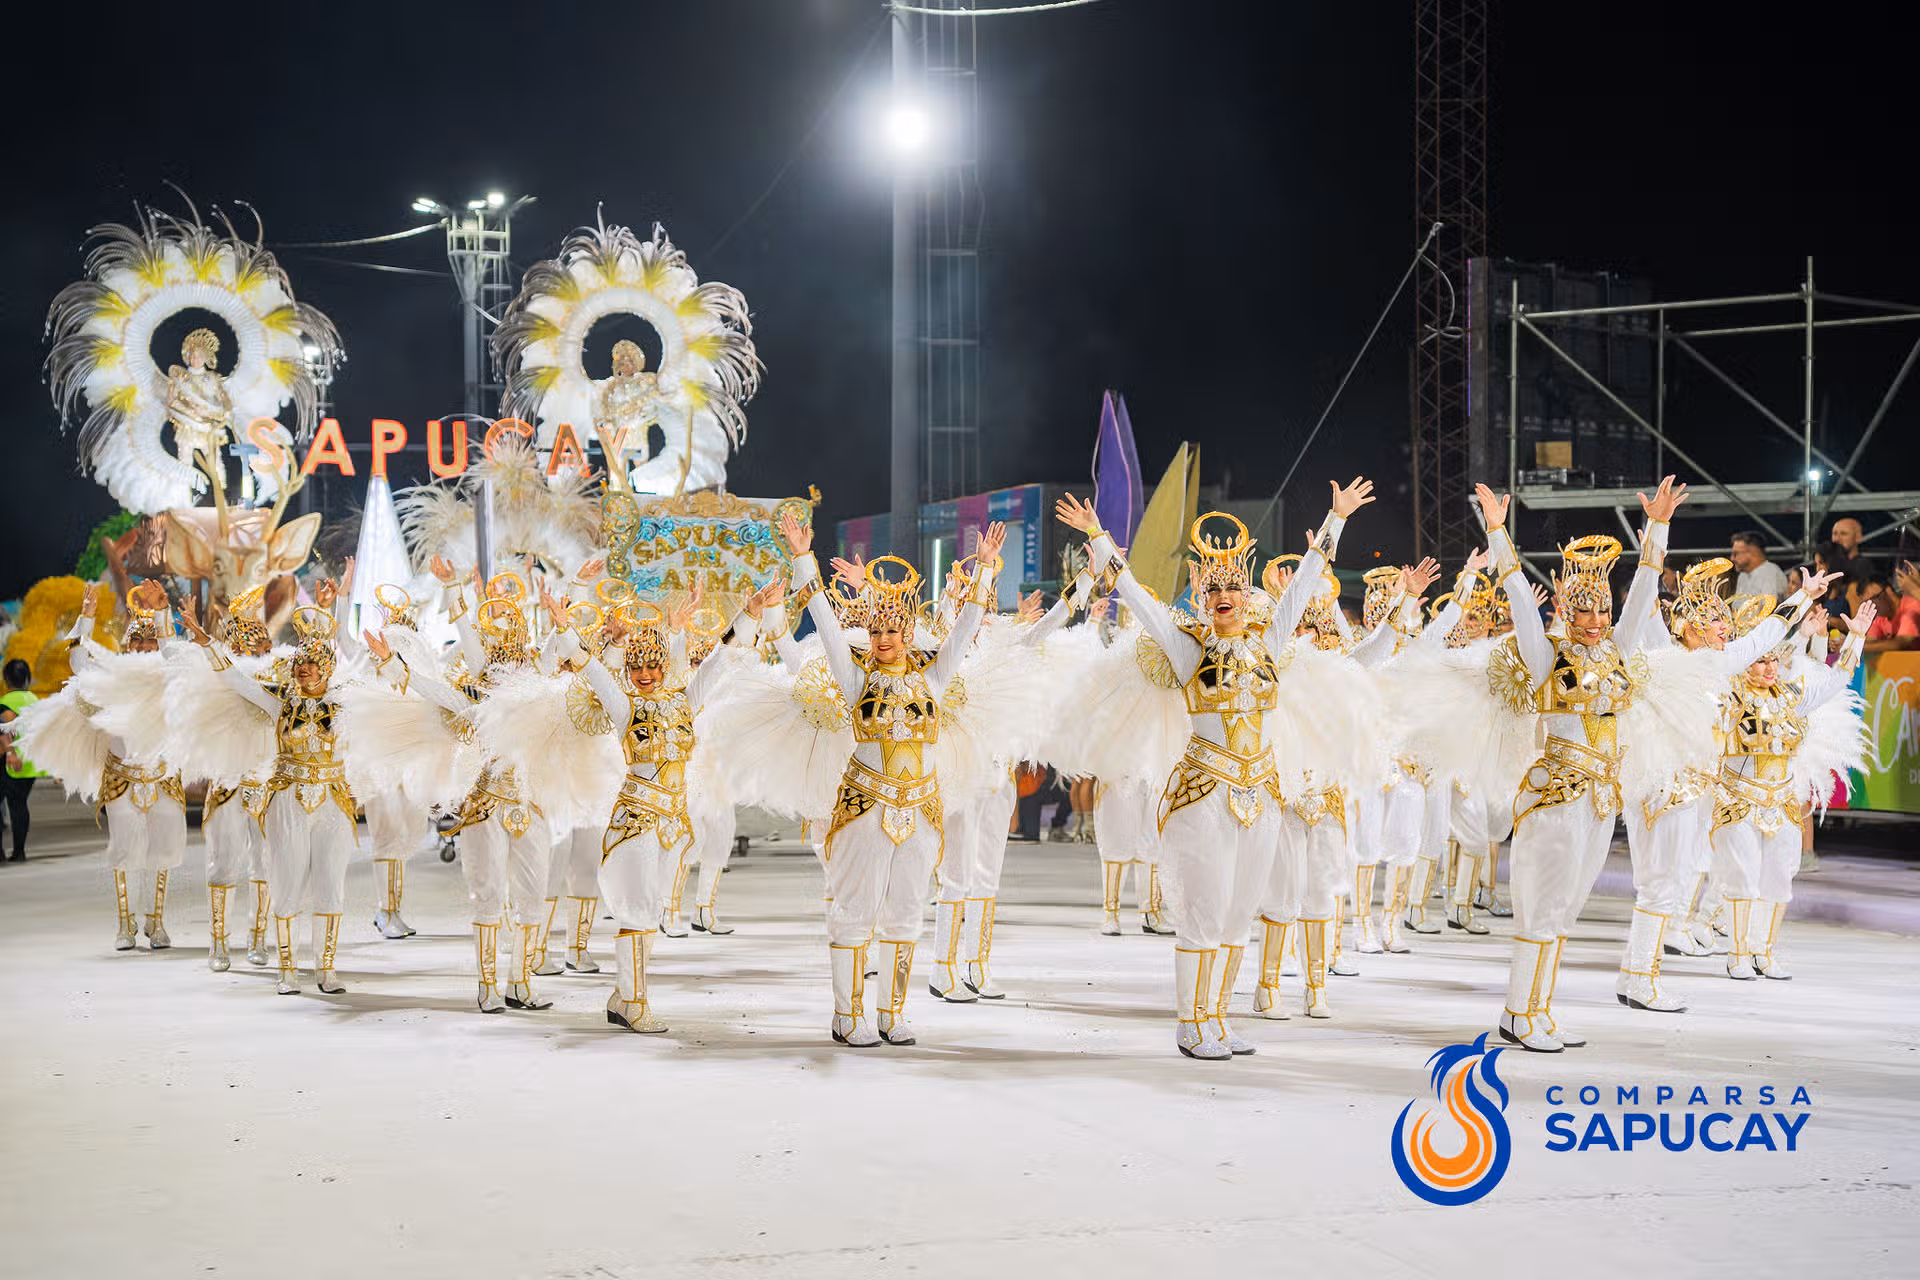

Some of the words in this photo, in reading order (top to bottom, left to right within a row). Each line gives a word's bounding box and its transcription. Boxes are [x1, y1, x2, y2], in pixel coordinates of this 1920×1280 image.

[248, 417, 629, 478] SAPUCAY
[632, 525, 779, 574] SAPUCAY
[683, 551, 727, 568] DEL
[1872, 676, 1920, 773] CA
